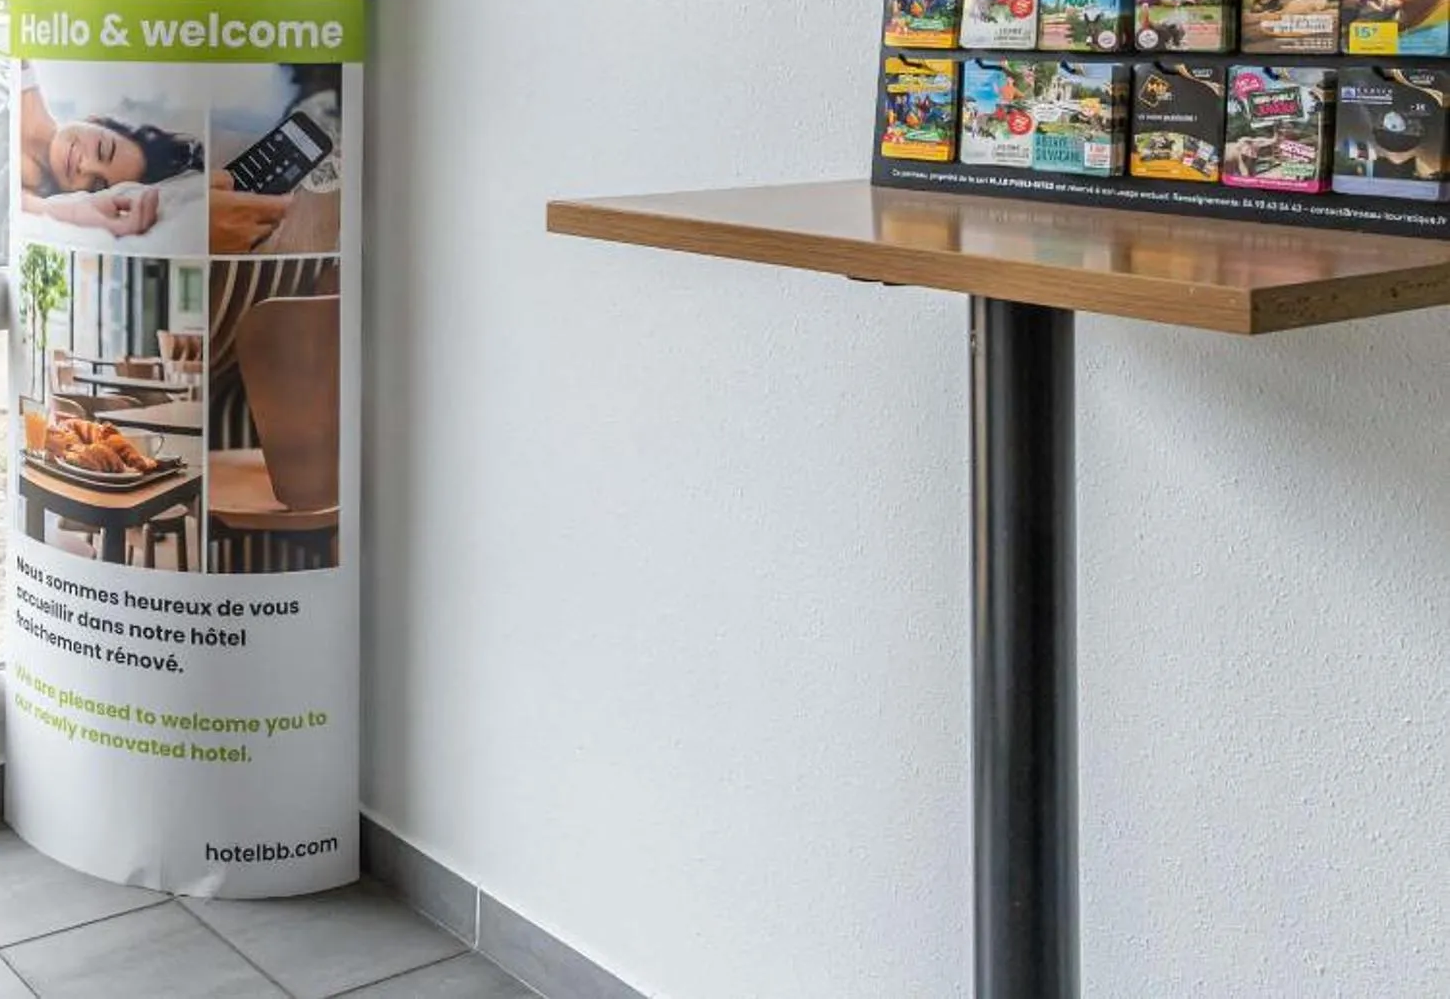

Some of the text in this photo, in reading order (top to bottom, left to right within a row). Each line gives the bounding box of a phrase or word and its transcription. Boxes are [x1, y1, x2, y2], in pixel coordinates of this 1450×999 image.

[21, 10, 344, 49] Hello & welcome
[17, 555, 300, 617] Nous sommes heureux de vous
[17, 586, 247, 647] accueillir dans notre hôtel
[106, 646, 185, 674] rénové.
[15, 692, 252, 763] our newly renovated hotel.
[34, 678, 55, 698] are
[59, 690, 130, 721] pleased
[136, 706, 156, 725] to
[160, 713, 260, 733] welcome
[266, 714, 303, 737] you
[309, 710, 327, 727] to
[205, 836, 339, 864] hotelbb.com
